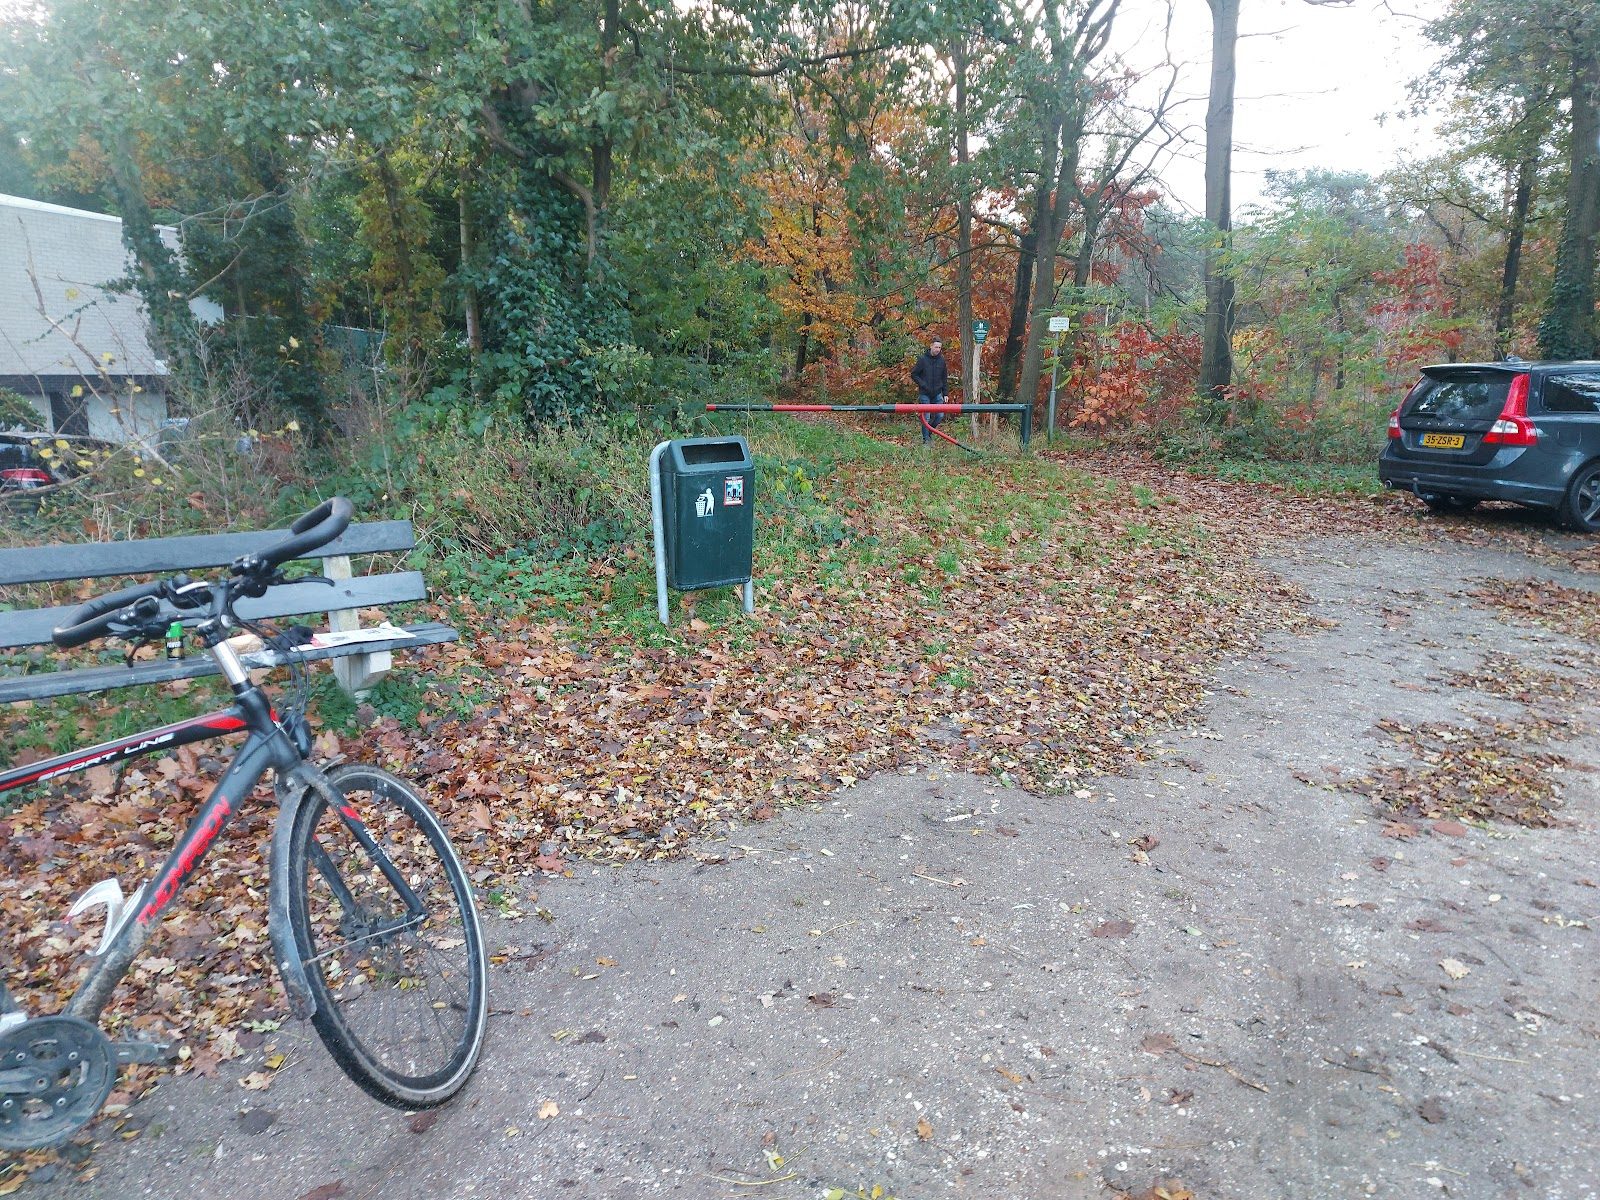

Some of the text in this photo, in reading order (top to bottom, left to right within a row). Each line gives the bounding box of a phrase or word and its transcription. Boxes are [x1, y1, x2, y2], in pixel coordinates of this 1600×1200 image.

[1425, 435, 1460, 446] 35-ZSR-3
[38, 732, 175, 781] SPORT LINE
[136, 795, 232, 925] THOMPSON
